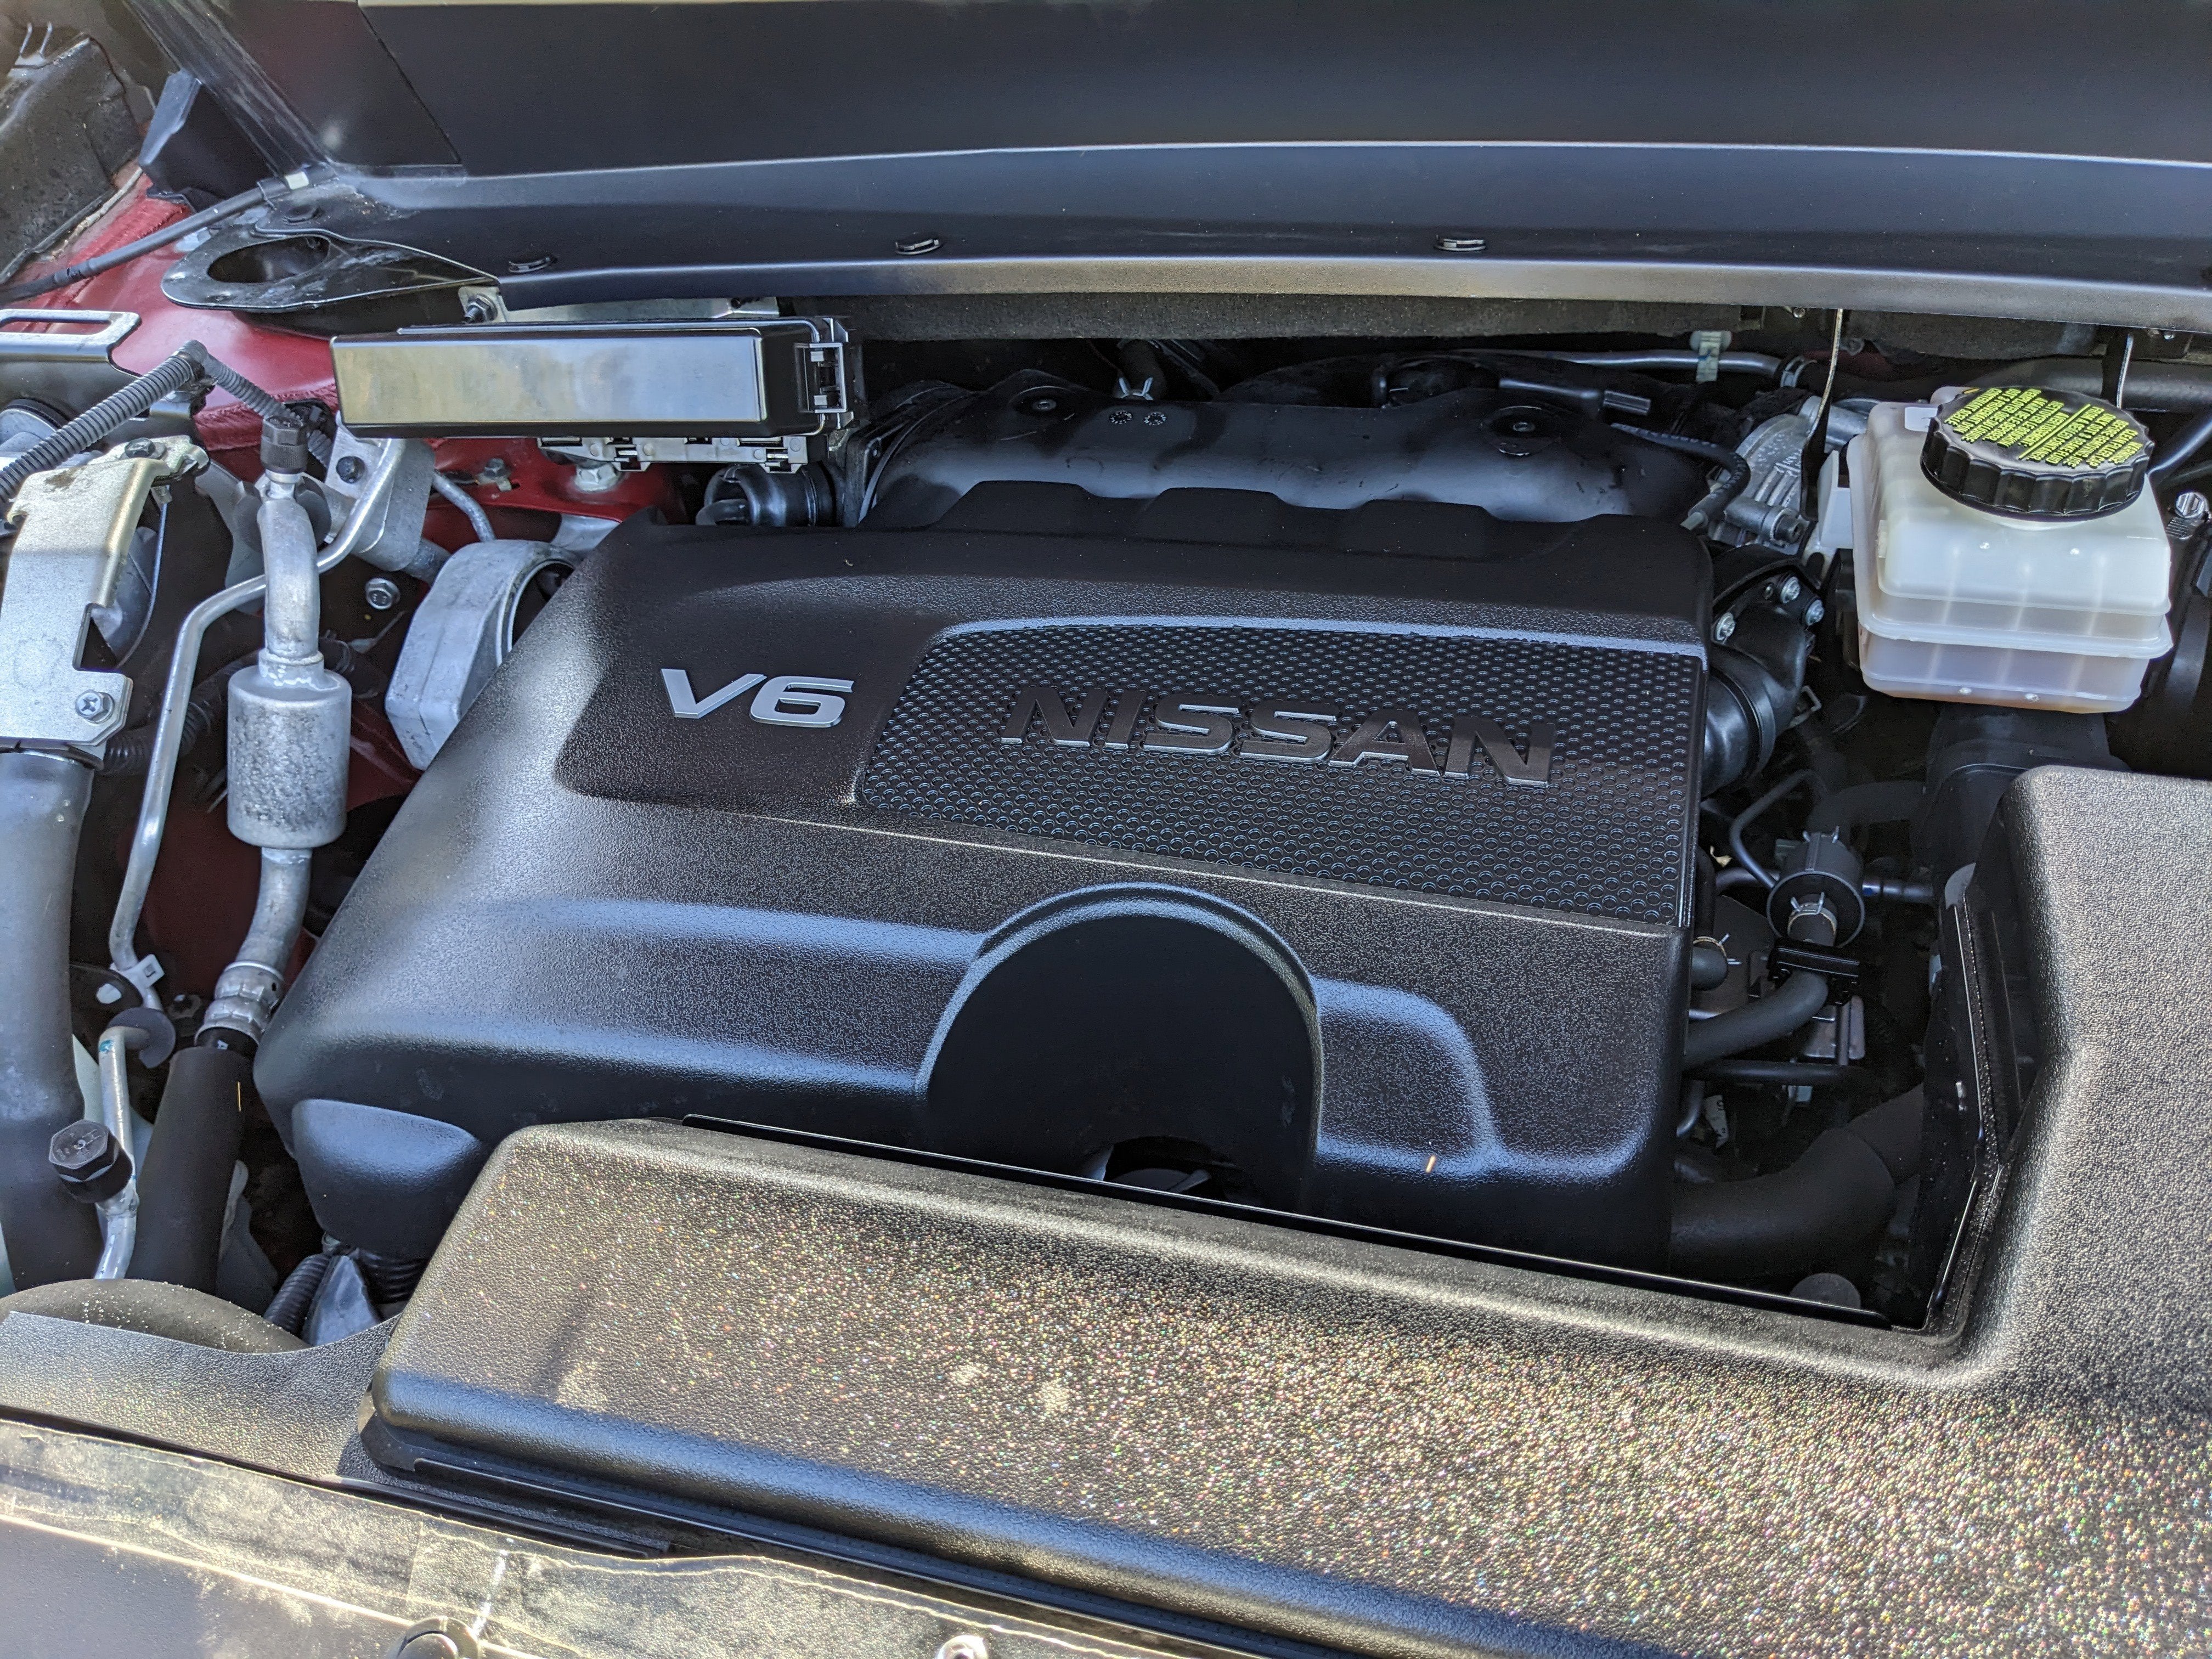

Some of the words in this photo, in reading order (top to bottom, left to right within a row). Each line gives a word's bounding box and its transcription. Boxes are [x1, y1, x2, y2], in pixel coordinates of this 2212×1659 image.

[1964, 388, 2002, 412] CONTENANT
[2001, 388, 2021, 399] DOT
[1966, 399, 2006, 424] PROVENANT
[2020, 397, 2048, 414] AVANT
[2026, 400, 2064, 424] NETTOYER
[2079, 406, 2104, 421] FROM
[1988, 410, 2011, 422] QUE
[2092, 412, 2116, 426] ONLY
[1961, 424, 1991, 442] LIQUIDE
[2055, 421, 2085, 439] SEALED
[2082, 422, 2103, 435] DOT
[2099, 419, 2128, 437] BEFORE
[2112, 428, 2137, 444] CLEAN
[1998, 426, 2030, 447] BOUCHON
[2058, 437, 2086, 453] BRAKE
[2093, 442, 2123, 458] FILLER
[2046, 449, 2069, 464] FLUID
[2063, 455, 2083, 467] USE
[2086, 454, 2105, 467] CAP
[661, 668, 855, 727] V6
[1000, 685, 1556, 788] NISSAN
